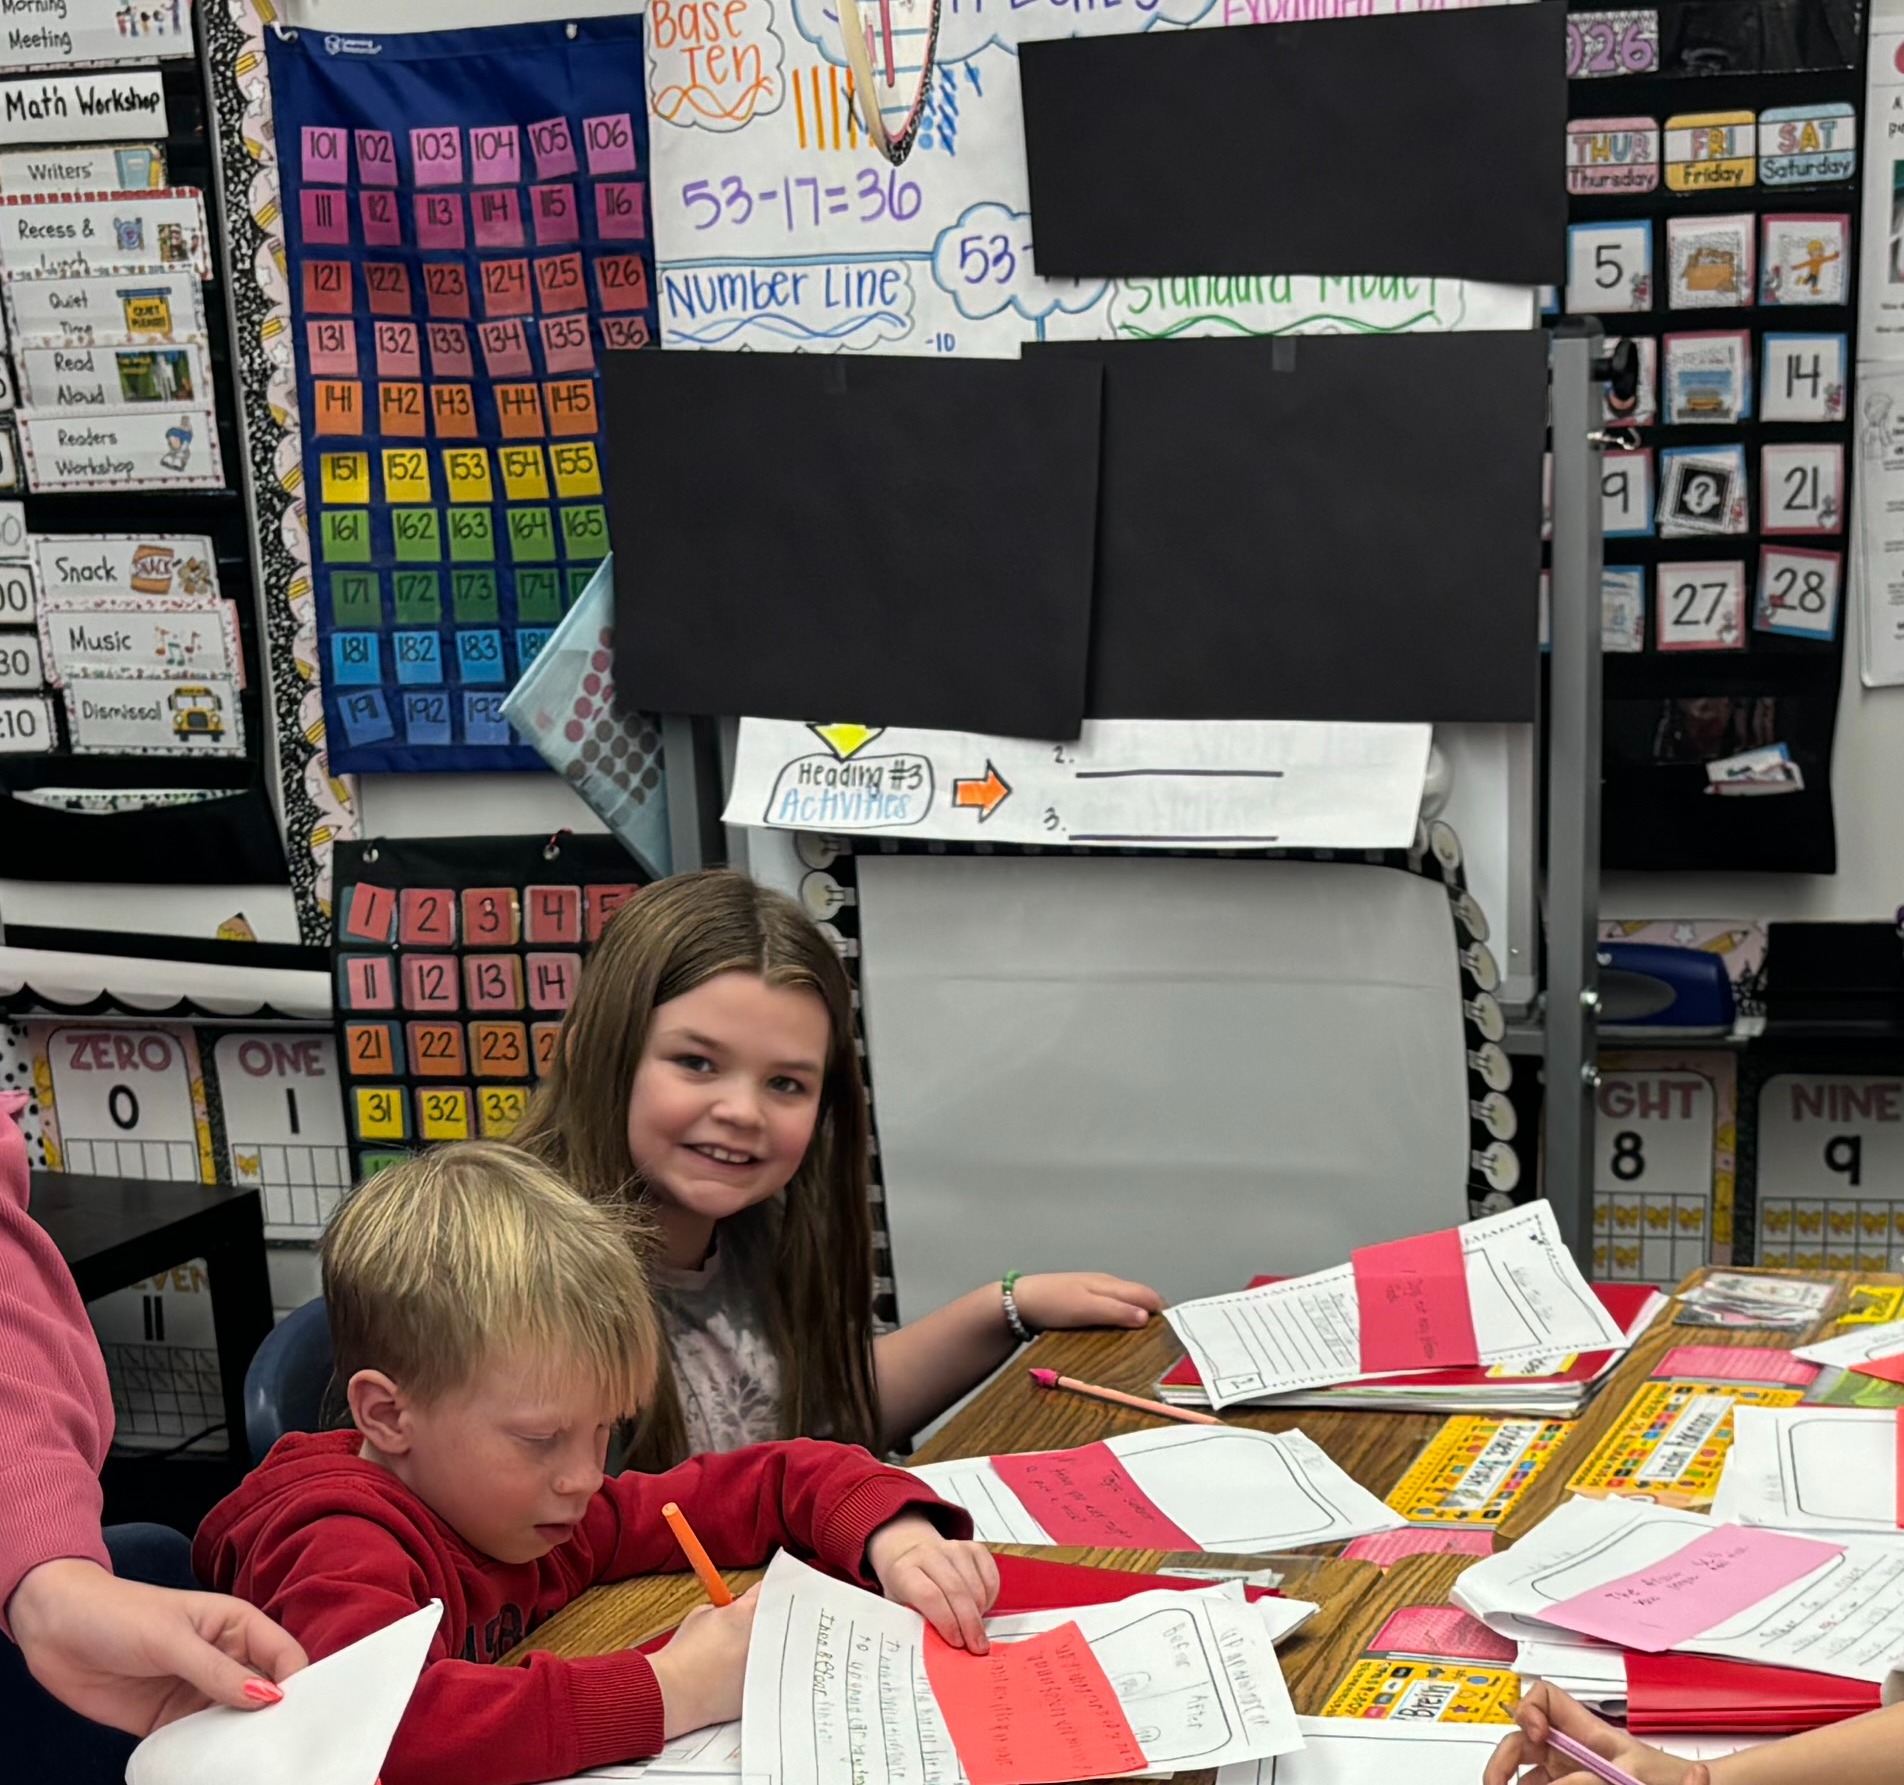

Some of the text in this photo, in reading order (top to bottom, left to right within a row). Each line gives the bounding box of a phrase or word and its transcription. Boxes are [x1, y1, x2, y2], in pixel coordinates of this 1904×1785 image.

[652, 0, 747, 48] Base
[9, 30, 72, 54] Meeting
[680, 44, 762, 86] Ten
[6, 87, 160, 122] Math Workshop
[310, 120, 629, 162] 101 103 104 106
[1571, 121, 1837, 163] THUR FRI SAT
[1570, 159, 1851, 189] Thursday Friday Saturday
[18, 219, 95, 240] Recess &
[313, 259, 641, 293] 121 124 125 126
[1596, 245, 1623, 289] 5
[49, 292, 88, 312] Quiet
[665, 266, 902, 319] Number Line
[61, 321, 92, 336] Time
[379, 320, 645, 353] 132 135 136
[54, 351, 95, 372] Read
[1787, 354, 1819, 399] 14
[57, 383, 105, 405] Aloud
[57, 428, 118, 447] Readers
[55, 458, 135, 478] Workshop
[387, 447, 593, 480] 152 155
[1784, 466, 1817, 510] 21
[397, 511, 603, 539] 162 165
[56, 555, 118, 584] Snack
[1673, 583, 1727, 626] 27
[1773, 568, 1825, 612] 28
[69, 629, 133, 653] Music
[82, 700, 162, 722] Dismissal
[1053, 746, 1074, 766] 2.
[797, 761, 924, 803] Heading #3
[779, 790, 908, 823] Activities
[1043, 806, 1067, 833] 3.
[418, 896, 563, 932] 2 3 4
[364, 964, 565, 1000] 11 12 13 14
[66, 1034, 172, 1071] ZERO
[238, 1040, 324, 1077] ONE
[357, 1029, 520, 1061] 21 22 23
[108, 1084, 139, 1130] 0
[286, 1088, 300, 1134] 1
[369, 1095, 462, 1122] 31 32
[1600, 1081, 1702, 1120] GHT
[1791, 1082, 1903, 1122] NINE
[1611, 1131, 1645, 1180] 8
[1824, 1135, 1860, 1186] 9
